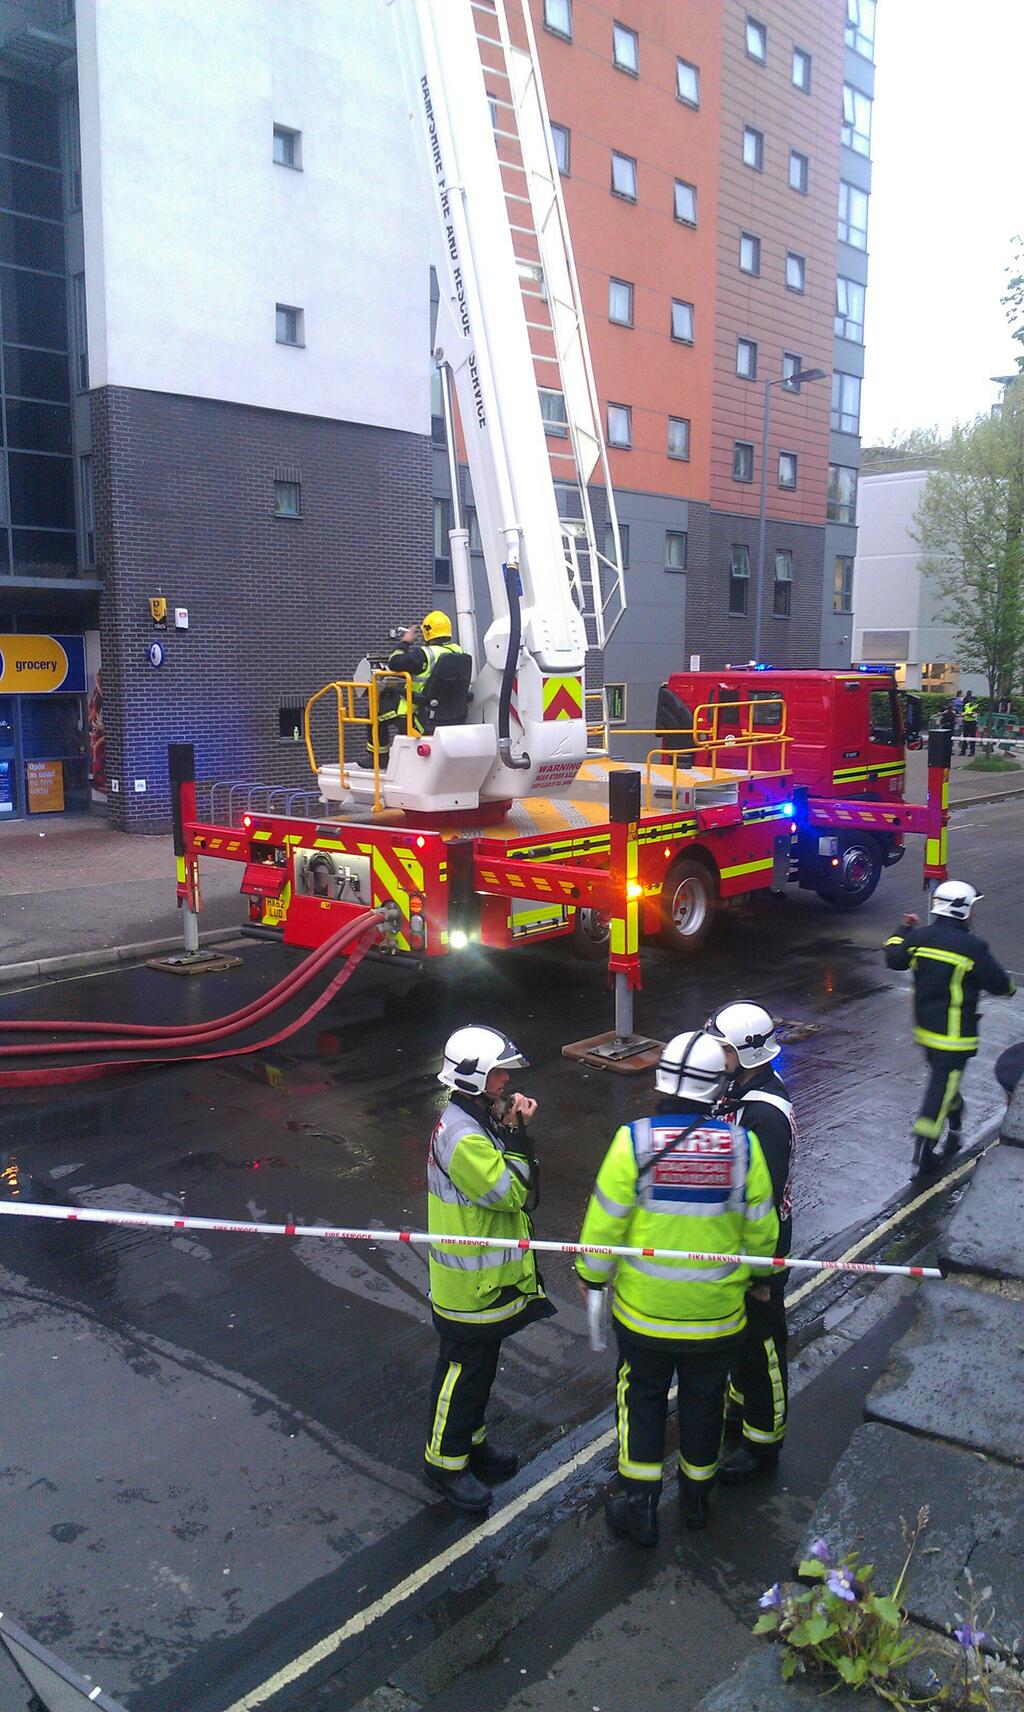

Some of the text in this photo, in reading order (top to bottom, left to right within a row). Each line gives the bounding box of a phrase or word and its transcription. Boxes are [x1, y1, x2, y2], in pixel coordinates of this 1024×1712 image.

[15, 659, 58, 672] grocery
[538, 761, 583, 773] WARNING
[653, 1130, 732, 1153] FIRE
[580, 1246, 613, 1254] SERVICE
[707, 1254, 742, 1263] SERVICE
